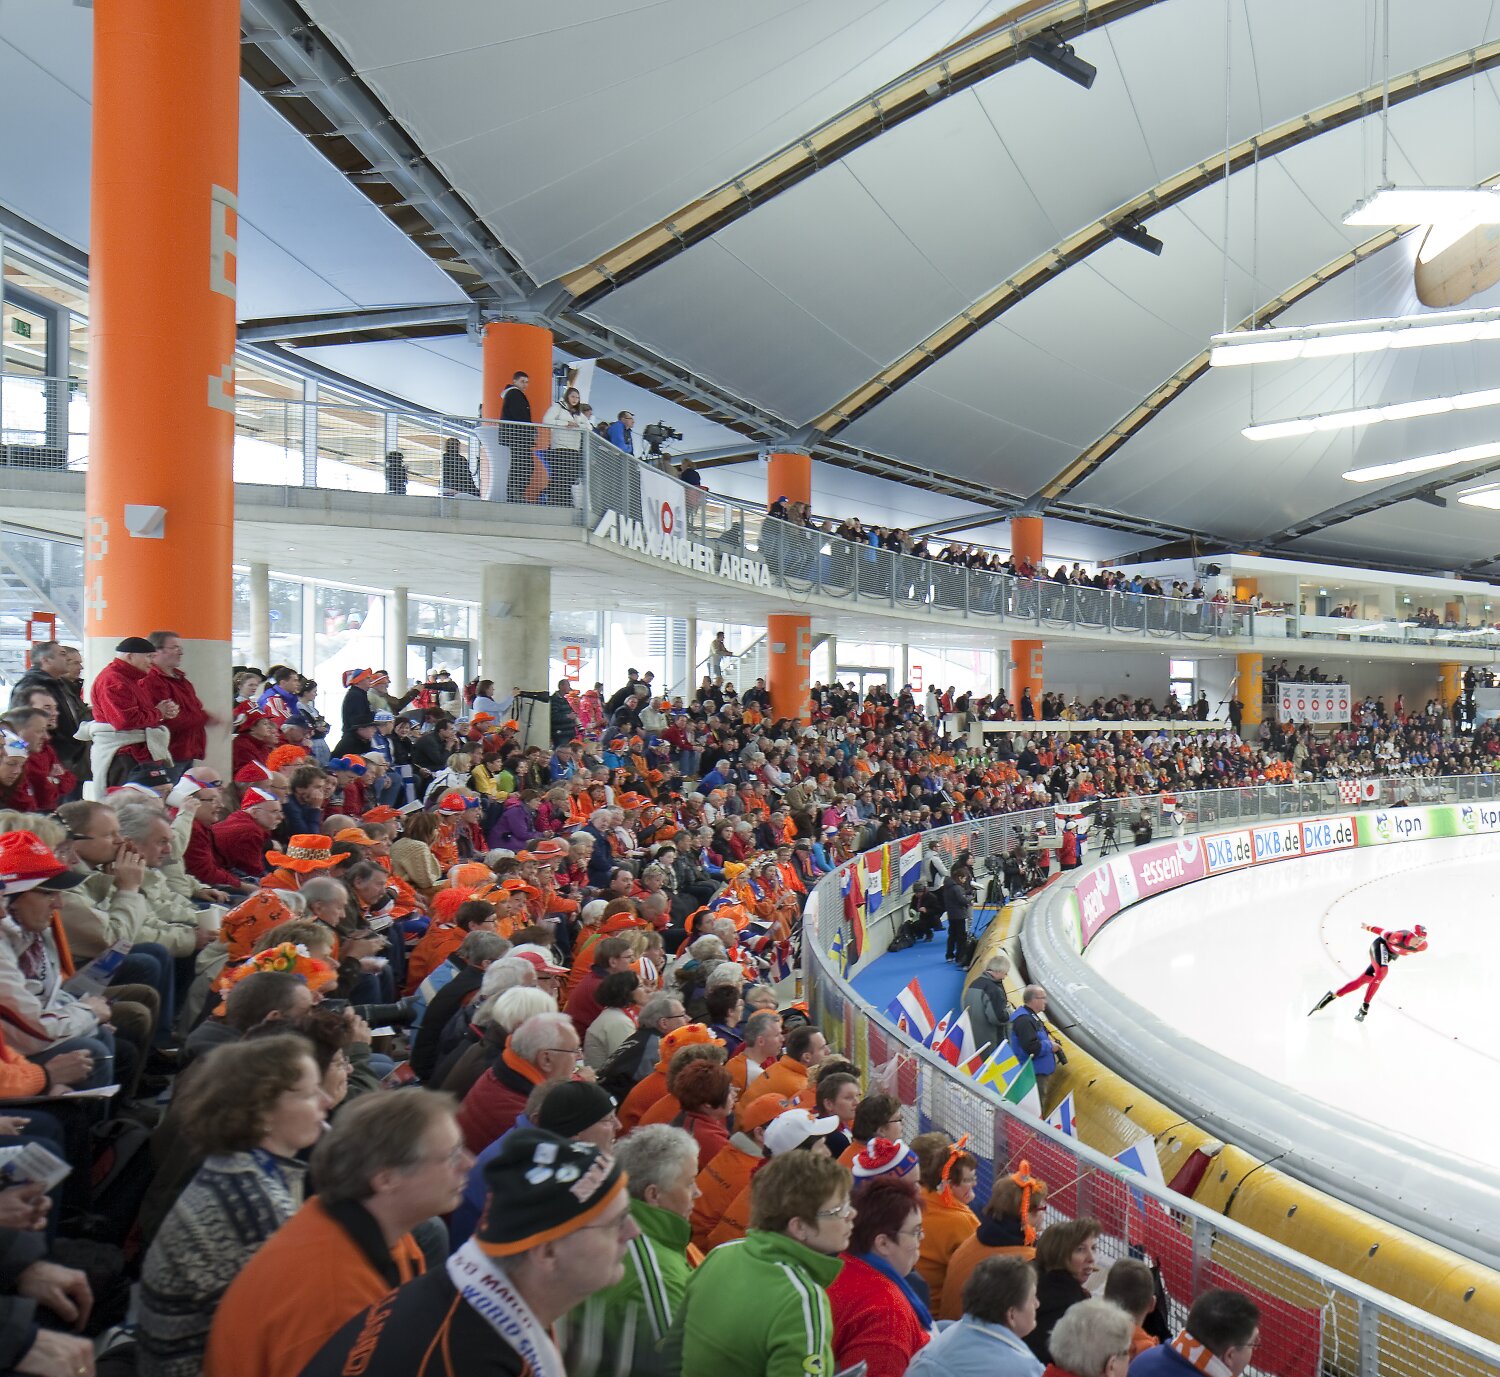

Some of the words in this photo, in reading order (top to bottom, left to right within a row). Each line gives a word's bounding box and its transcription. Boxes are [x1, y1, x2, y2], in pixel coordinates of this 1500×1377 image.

[619, 514, 657, 558] MAX
[661, 533, 716, 575] AICHER
[719, 552, 772, 588] ARENA
[1304, 822, 1352, 848] DKB.de
[1394, 815, 1423, 836] kpn
[1206, 836, 1250, 867] DKB.de
[1255, 829, 1299, 857] DKB.de
[1140, 848, 1185, 886] essent
